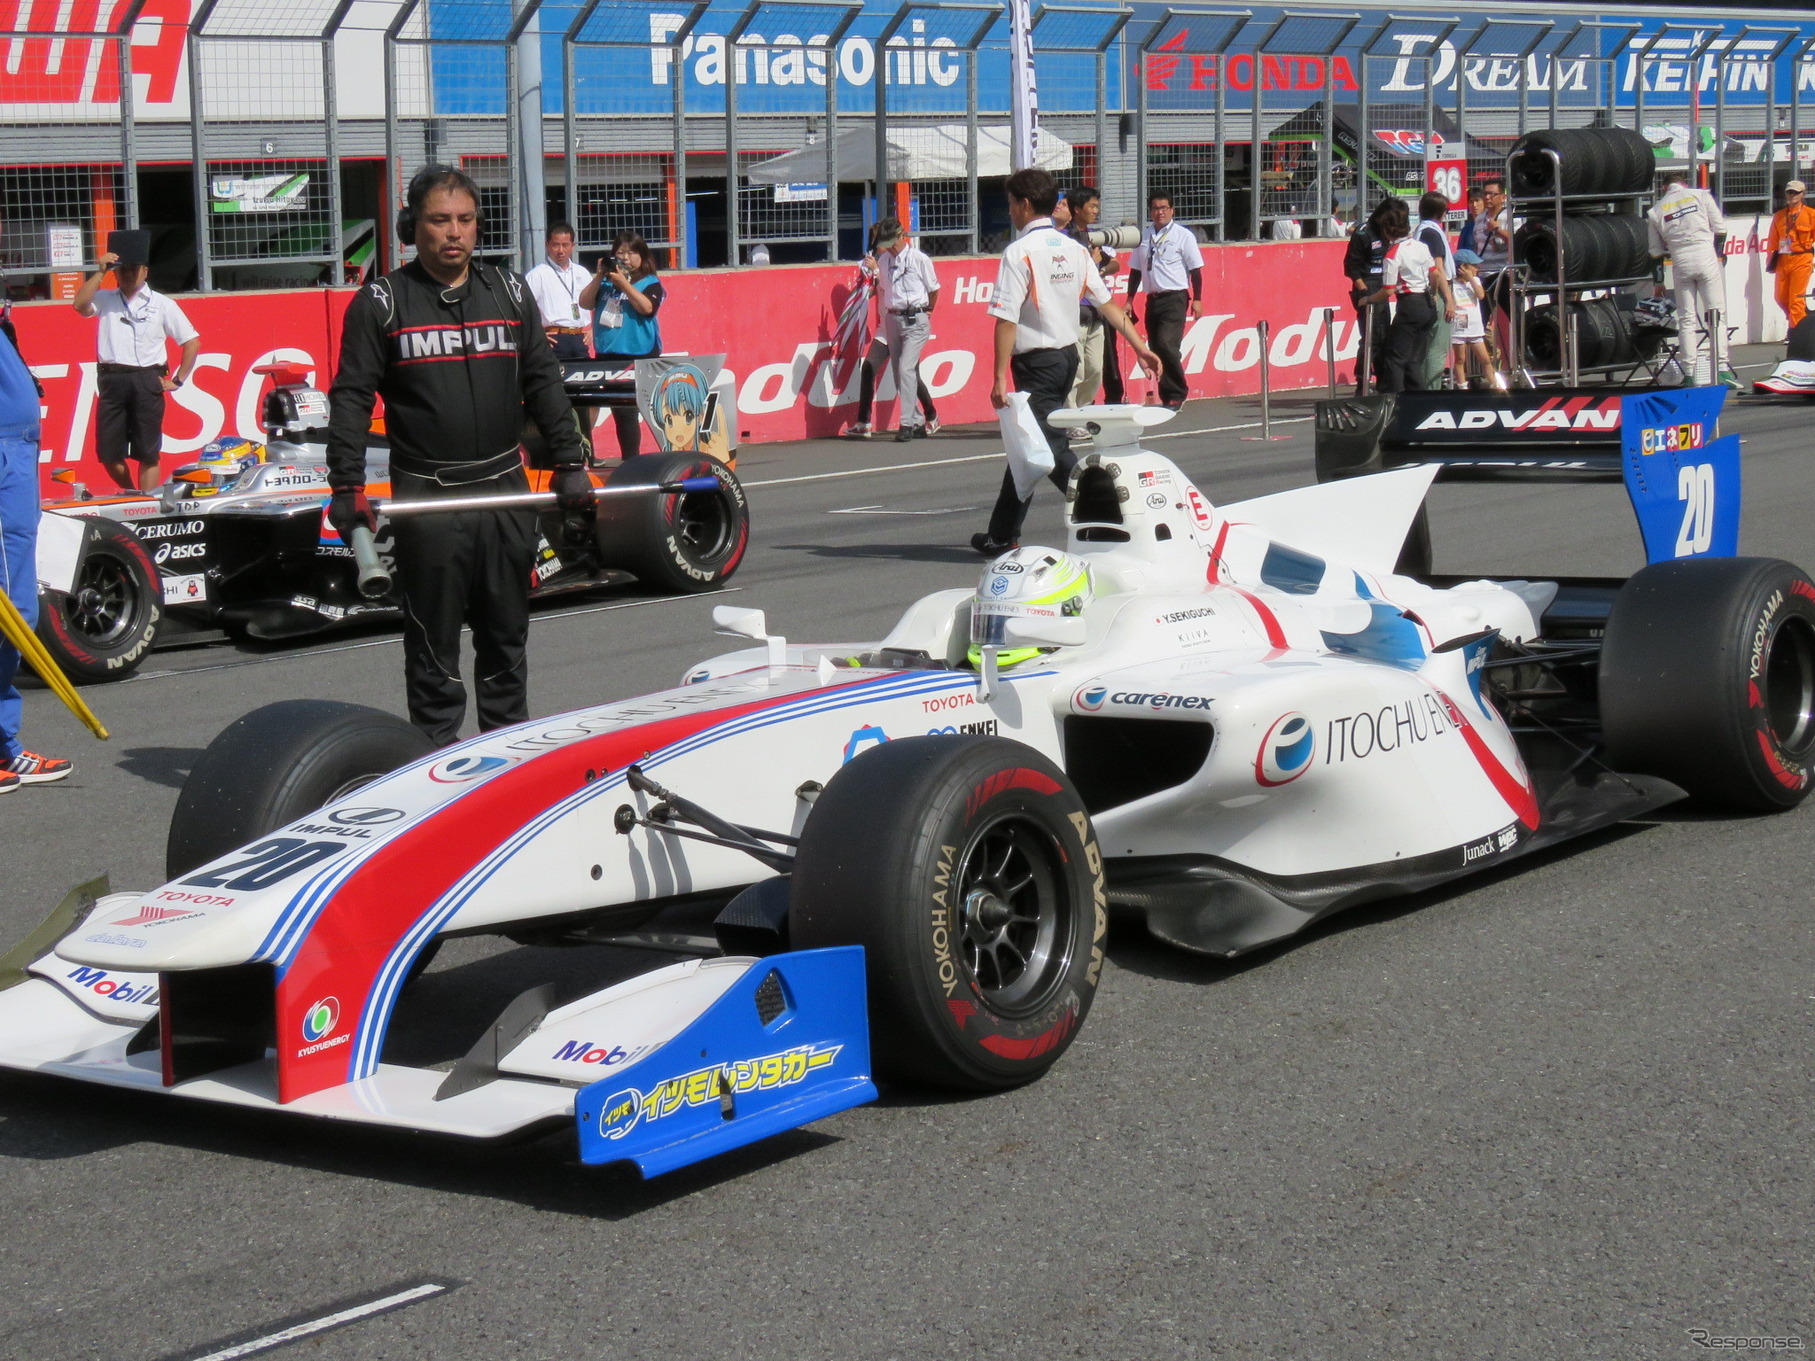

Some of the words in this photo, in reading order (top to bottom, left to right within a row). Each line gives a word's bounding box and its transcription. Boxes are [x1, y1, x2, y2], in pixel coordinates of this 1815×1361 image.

[649, 13, 960, 86] Panasonic
[1189, 53, 1359, 91] HONDA
[1380, 34, 1591, 91] DREAM
[265, 142, 274, 154] 6
[1433, 166, 1461, 203] 36
[399, 326, 517, 359] IMPUL
[564, 370, 636, 382] ADVA
[701, 391, 720, 432] 1
[1415, 409, 1620, 431] ADVAN
[711, 463, 745, 508] YOKOHAMA
[123, 506, 158, 517] TOYOTA
[1188, 491, 1209, 522] E
[1675, 463, 1715, 558] 20
[136, 520, 205, 541] CERUMO
[171, 542, 206, 559] asics
[666, 535, 716, 583] ADVAN
[999, 561, 1020, 572] Arai
[1026, 607, 1056, 617] TOYOTA
[1162, 607, 1216, 624] Y.SEKIGUCHI
[106, 603, 160, 670] ADVAN
[1750, 589, 1783, 680] YOKOHAMA
[922, 693, 975, 713] TOYOTA
[506, 703, 678, 752] ITOCHU
[1326, 695, 1428, 765] ITOCHU
[1424, 688, 1469, 736] ENE
[288, 823, 373, 839] IMPUL
[178, 837, 348, 892] 20
[1462, 836, 1496, 867] Junack
[155, 891, 236, 907] TOYOTA
[1067, 810, 1108, 987] ADVAN
[143, 911, 206, 928] YOKOHAMA
[931, 844, 957, 998] YOKOHAMA
[66, 966, 155, 1004] Mobil
[641, 1042, 845, 1118] イツモレンタカー
